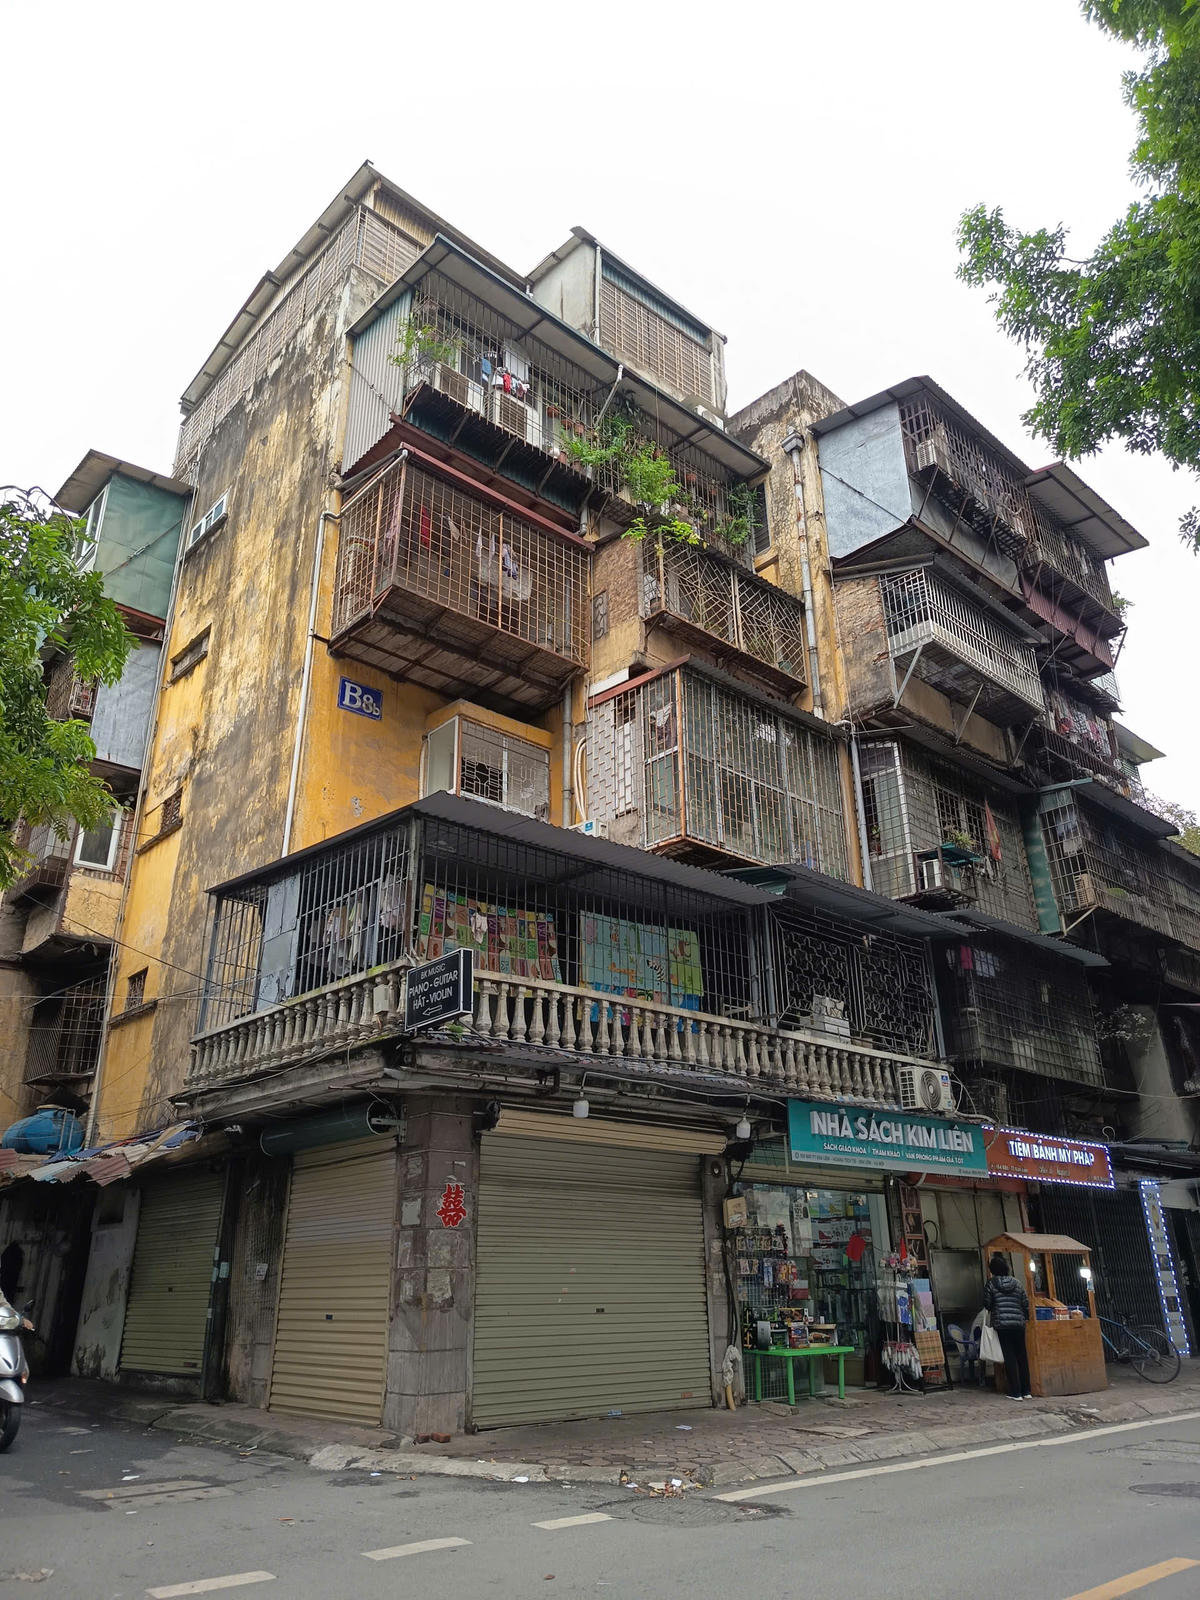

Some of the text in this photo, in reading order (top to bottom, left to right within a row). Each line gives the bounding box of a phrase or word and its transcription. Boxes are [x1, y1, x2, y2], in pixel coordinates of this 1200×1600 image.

[427, 963, 446, 977] MUSIC
[409, 981, 429, 998] PIANO
[433, 970, 458, 988] GUITAR
[412, 994, 426, 1010] HÁT
[429, 986, 453, 1004] VIOLIN
[810, 1108, 974, 1153] NHÀ SÁCH KIM LIÊN
[1008, 1137, 1031, 1161] TIỆM
